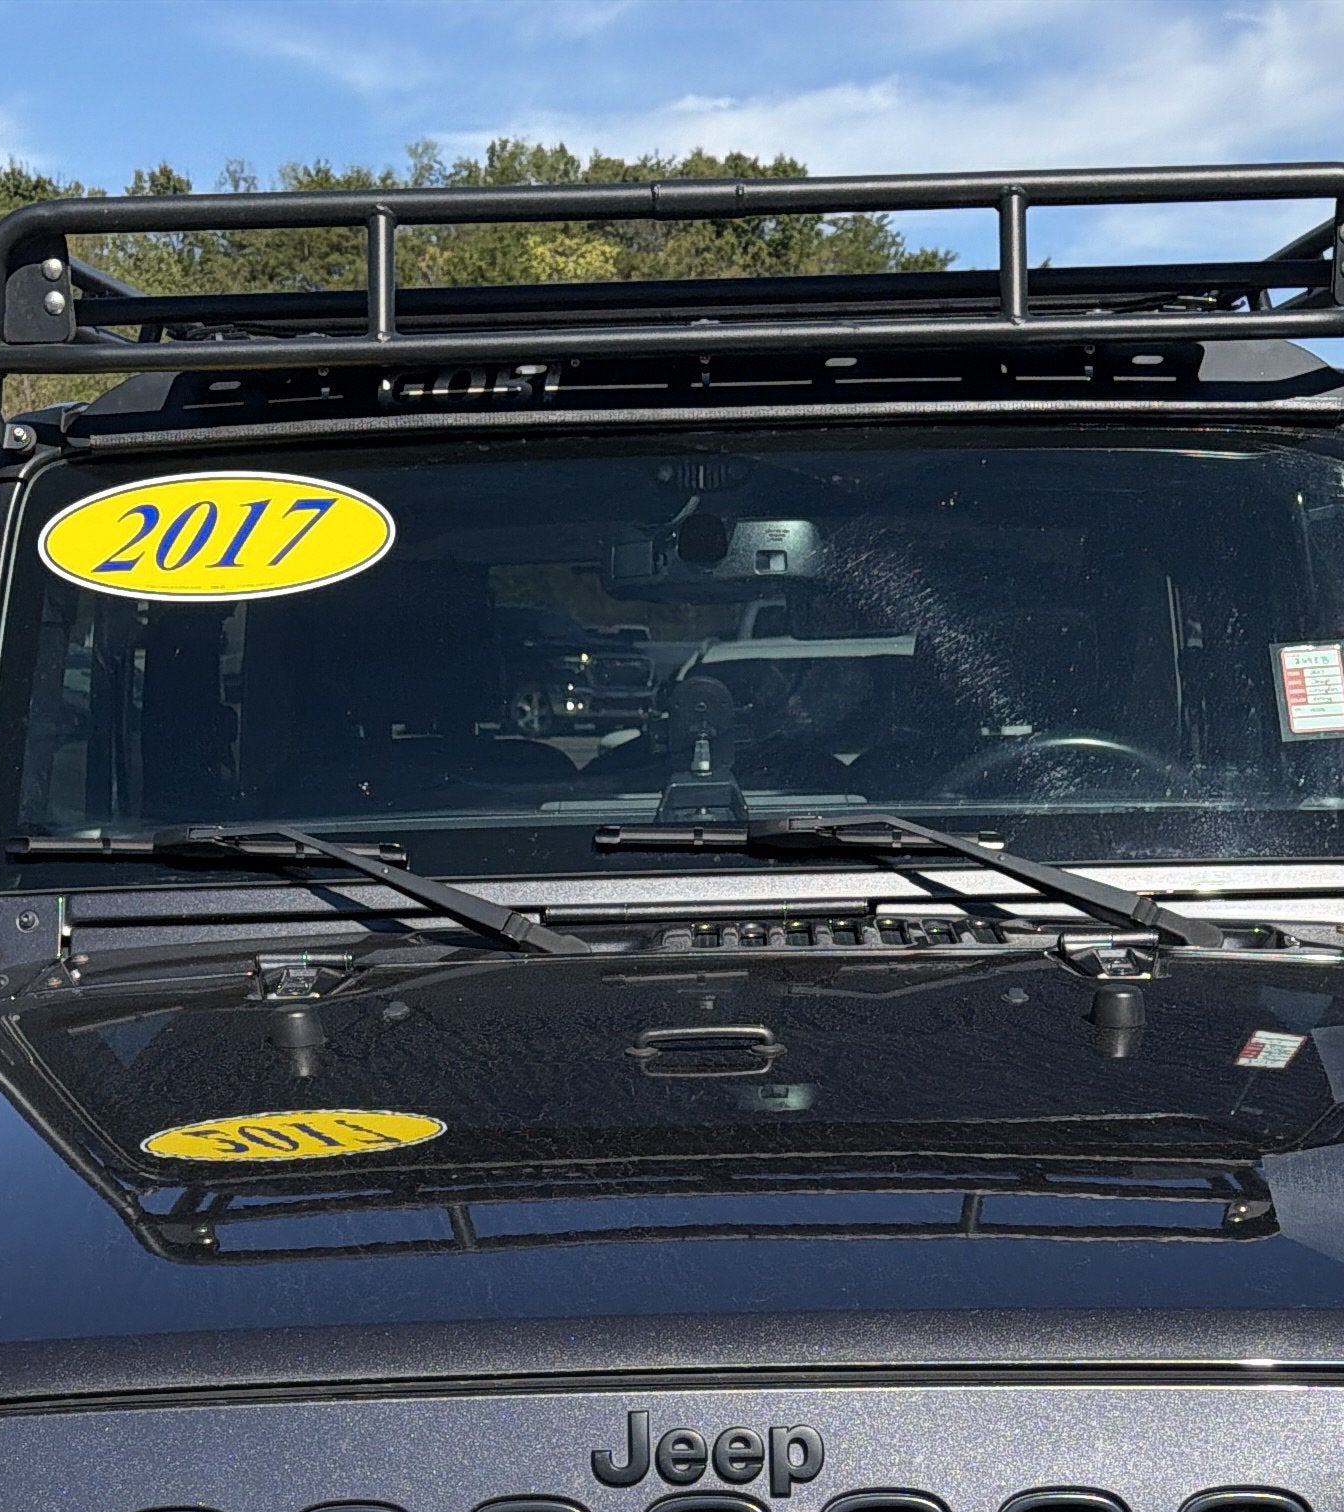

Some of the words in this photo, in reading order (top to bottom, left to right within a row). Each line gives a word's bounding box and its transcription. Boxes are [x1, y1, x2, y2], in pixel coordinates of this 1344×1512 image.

[377, 363, 562, 408] GOBI
[91, 498, 340, 573] 2017
[591, 1410, 825, 1498] Jeep
